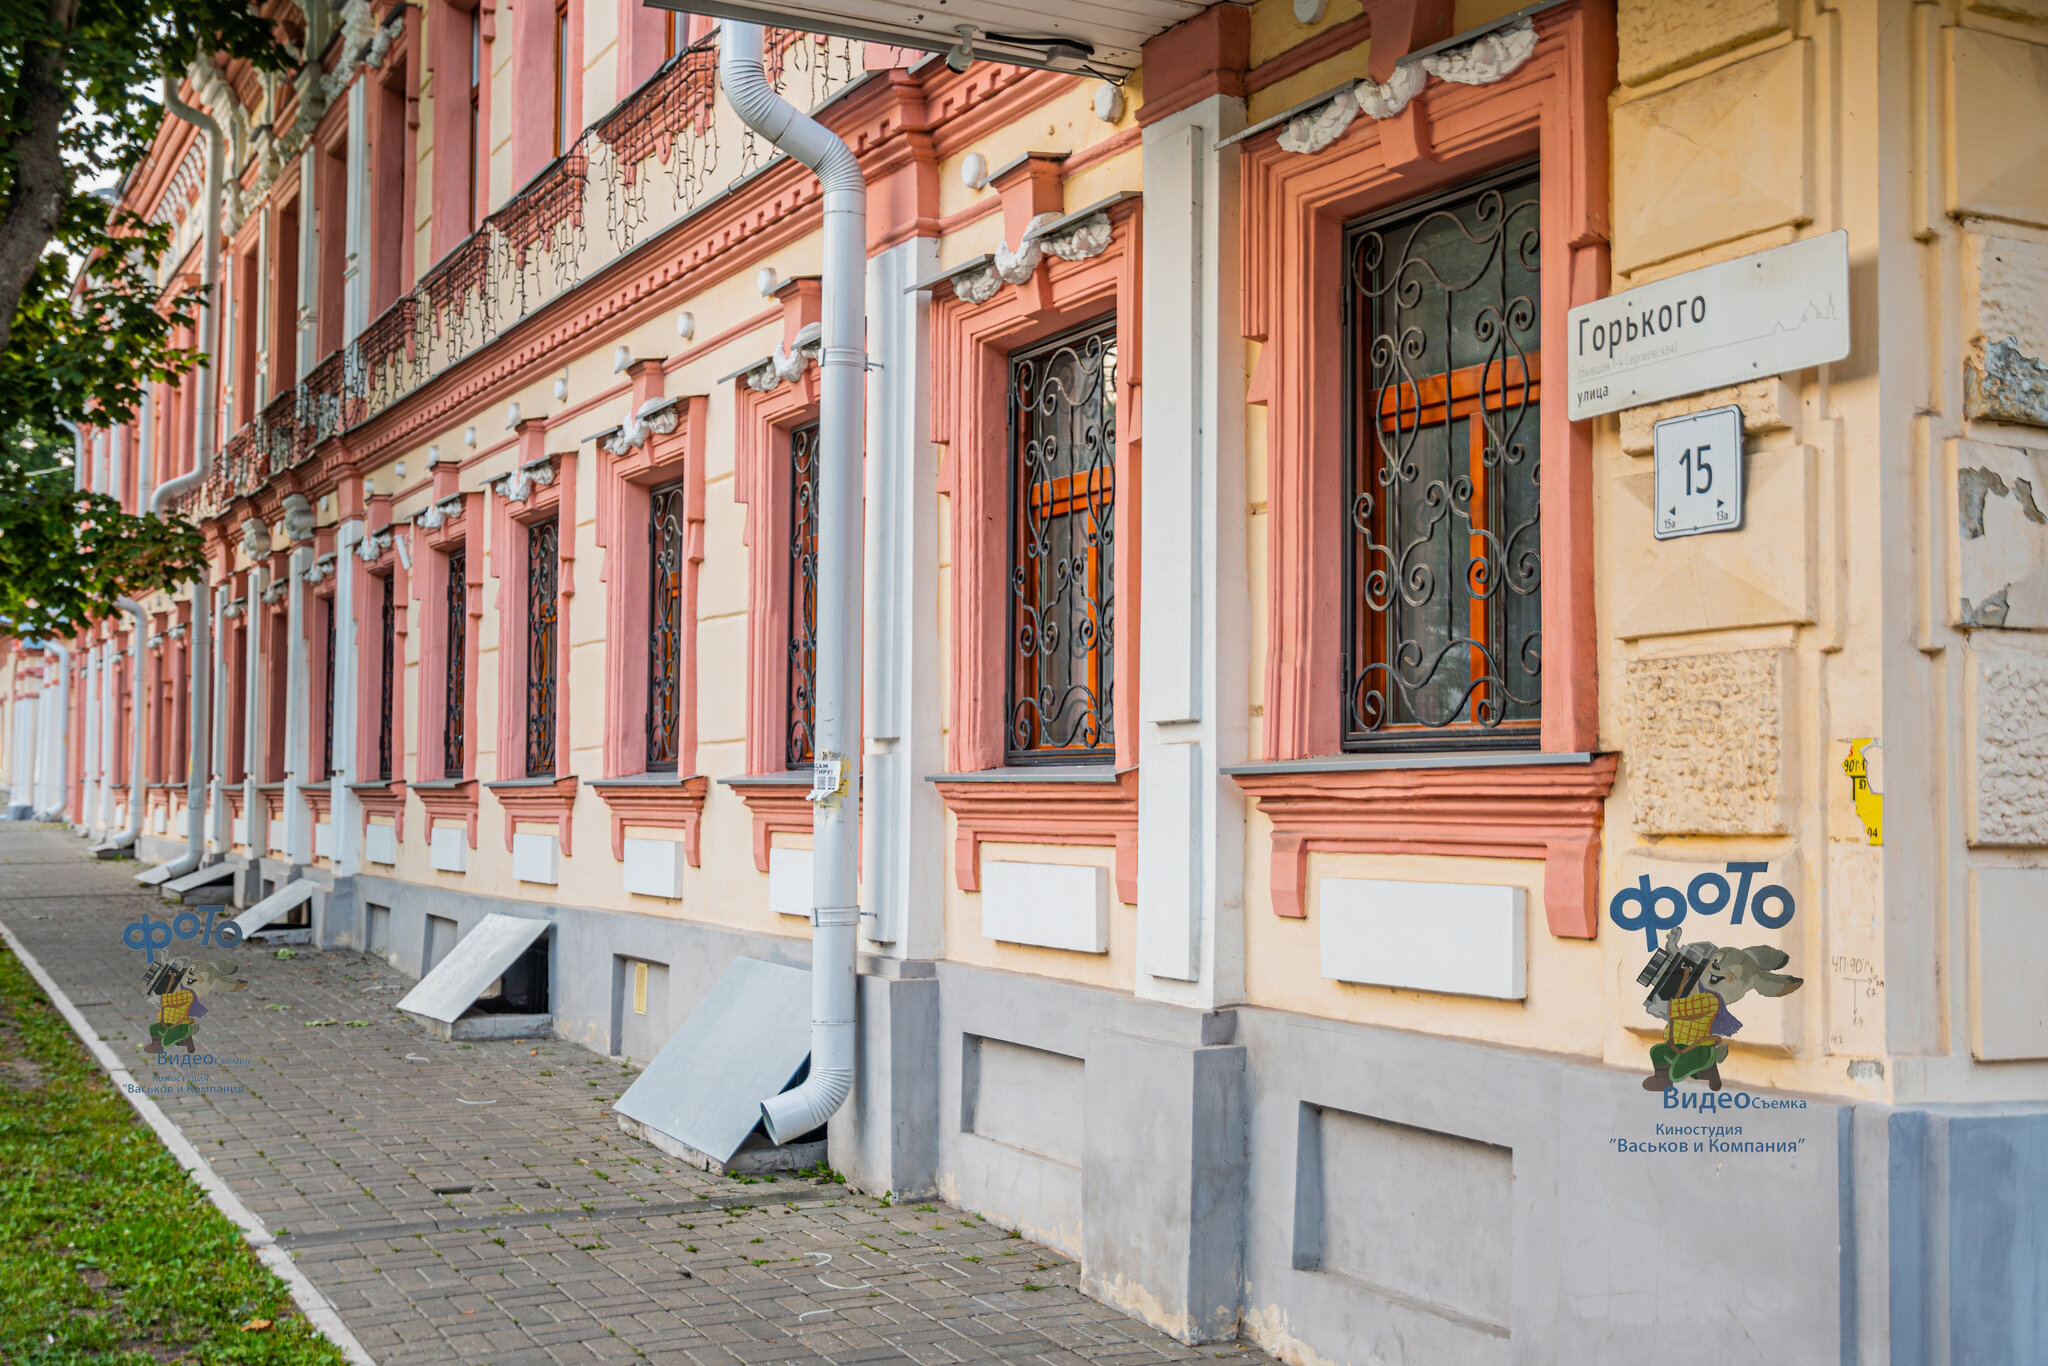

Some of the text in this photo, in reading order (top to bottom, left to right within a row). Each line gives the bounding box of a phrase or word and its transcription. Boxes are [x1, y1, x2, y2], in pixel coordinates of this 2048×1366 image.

[1578, 295, 1706, 358] Горького
[1577, 385, 1608, 408] улица
[1678, 444, 1713, 496] 15
